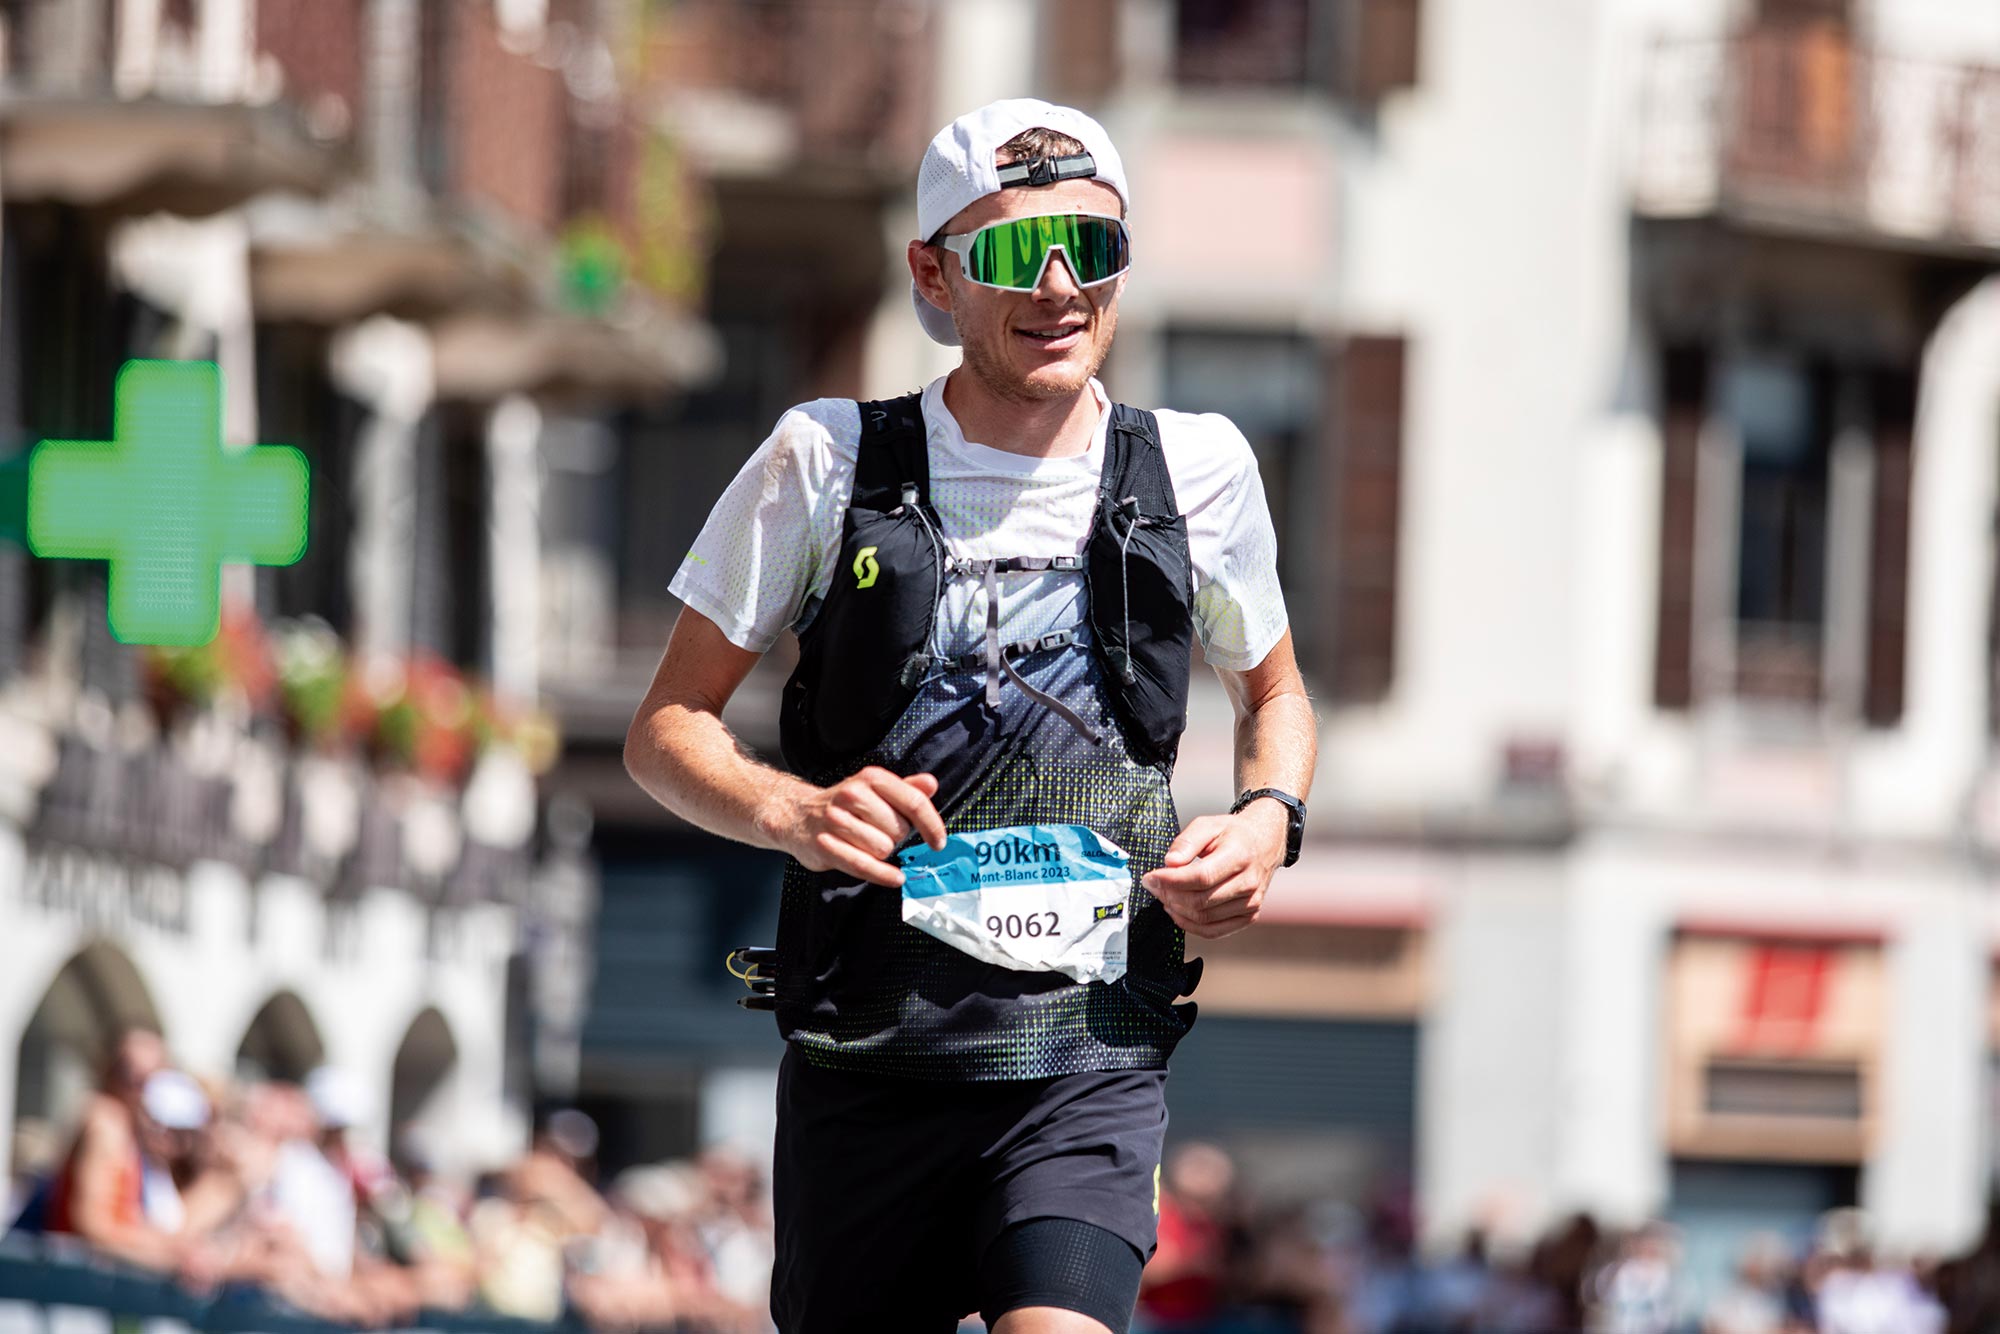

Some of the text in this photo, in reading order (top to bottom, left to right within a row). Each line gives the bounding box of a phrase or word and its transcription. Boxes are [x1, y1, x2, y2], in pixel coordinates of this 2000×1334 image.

[975, 837, 1061, 867] 90km
[970, 866, 1071, 884] Mont-Blanc 2023
[986, 911, 1061, 939] 9062
